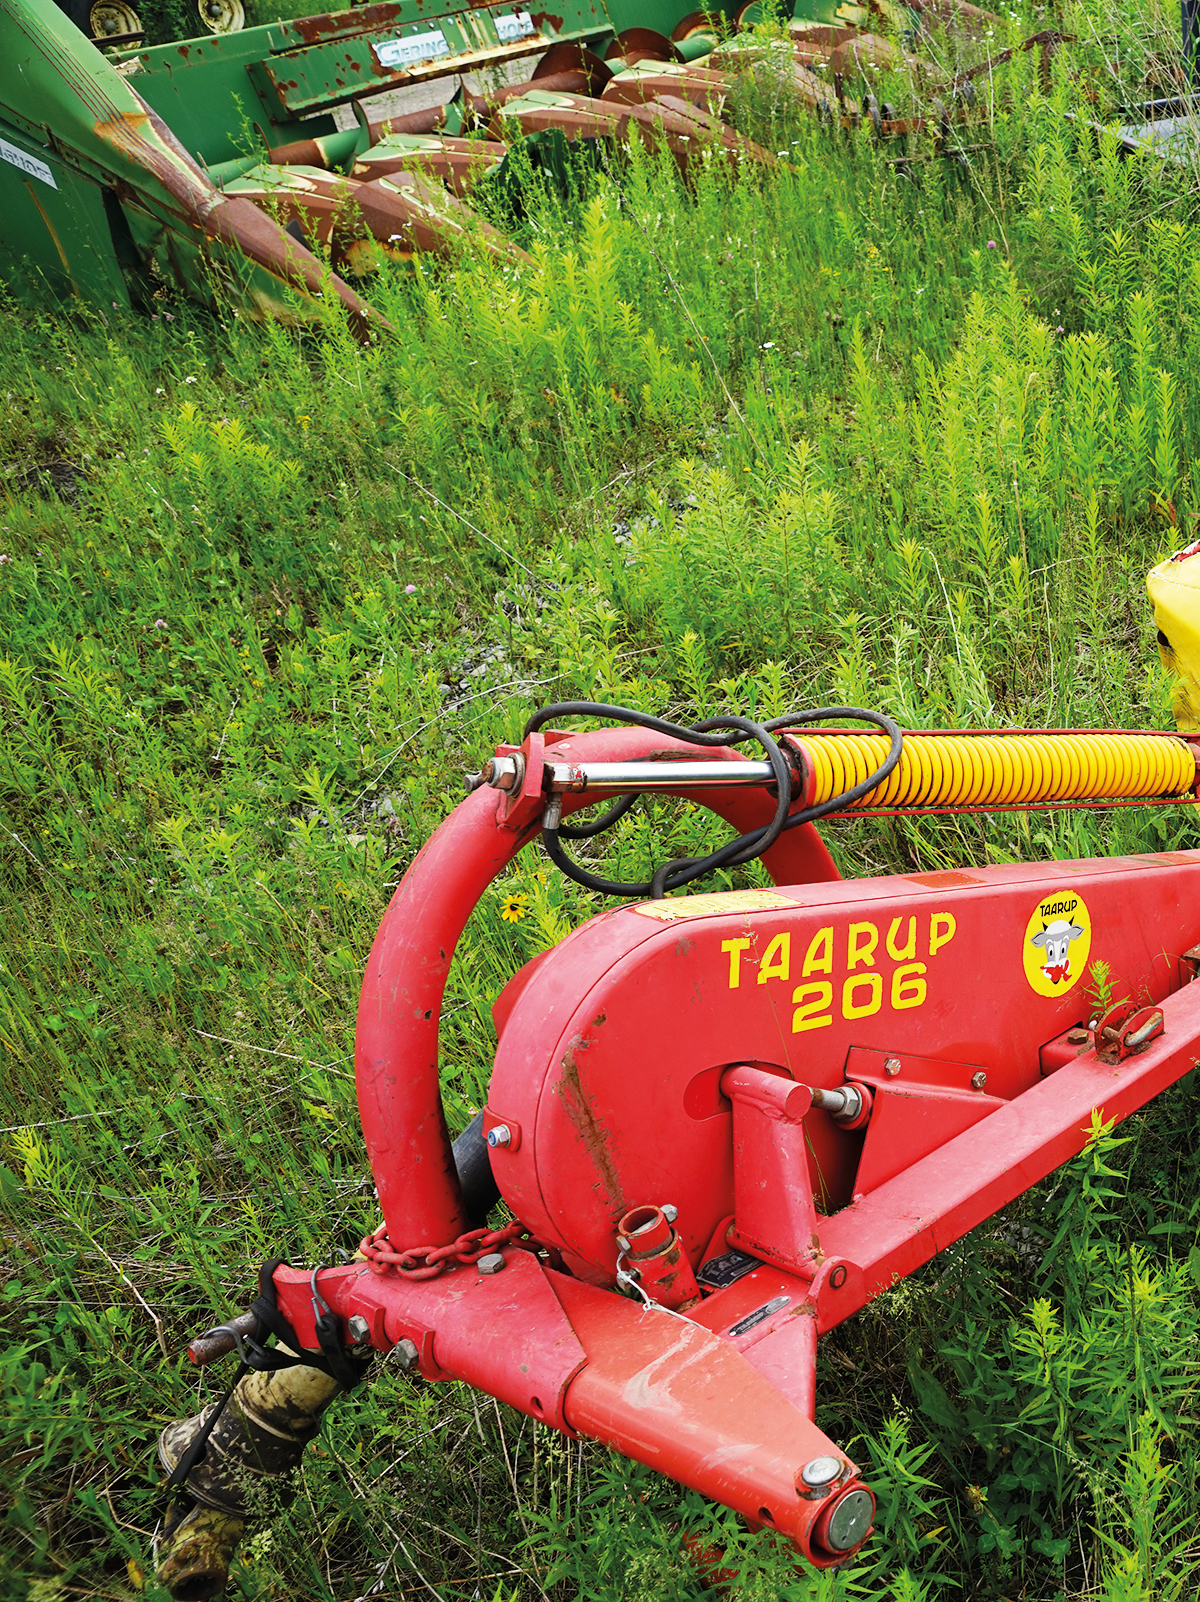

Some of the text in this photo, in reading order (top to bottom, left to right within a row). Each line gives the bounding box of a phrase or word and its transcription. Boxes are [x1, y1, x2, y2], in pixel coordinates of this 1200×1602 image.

[377, 39, 449, 64] GERING
[1040, 899, 1078, 917] TAARUP
[721, 912, 957, 989] TAARUP
[792, 962, 928, 1034] 206
